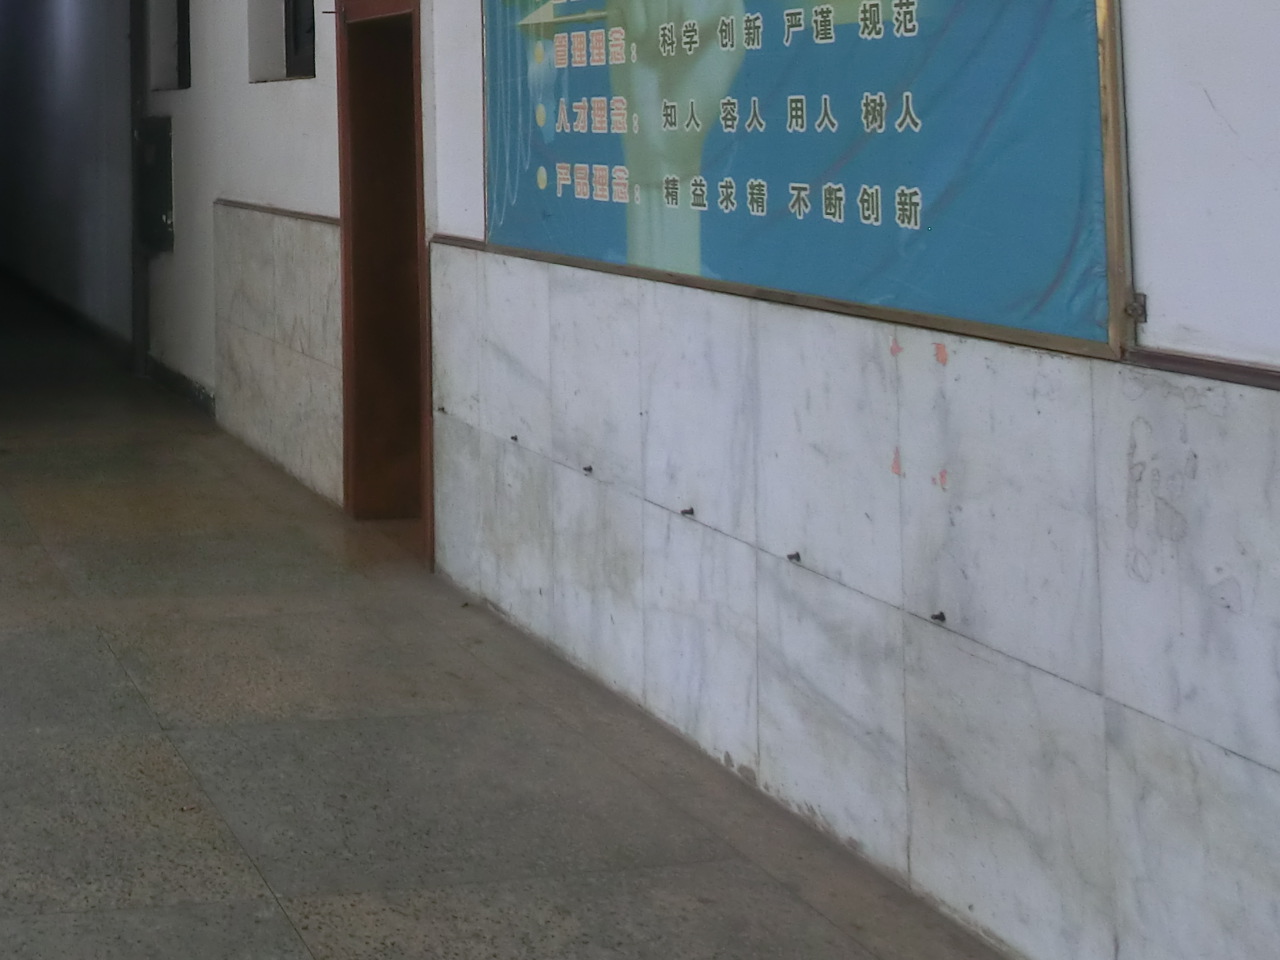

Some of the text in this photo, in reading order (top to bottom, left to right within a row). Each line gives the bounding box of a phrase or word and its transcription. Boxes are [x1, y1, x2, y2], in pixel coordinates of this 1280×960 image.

[659, 20, 699, 56] 科学
[717, 13, 763, 51] 创新
[784, 4, 834, 45] 严谨
[662, 100, 701, 131] 知人
[719, 96, 766, 132] 容人
[787, 94, 838, 132] 用人
[861, 91, 920, 133] 树人
[663, 177, 767, 216] 精益求精
[789, 182, 920, 230] 不断创新
